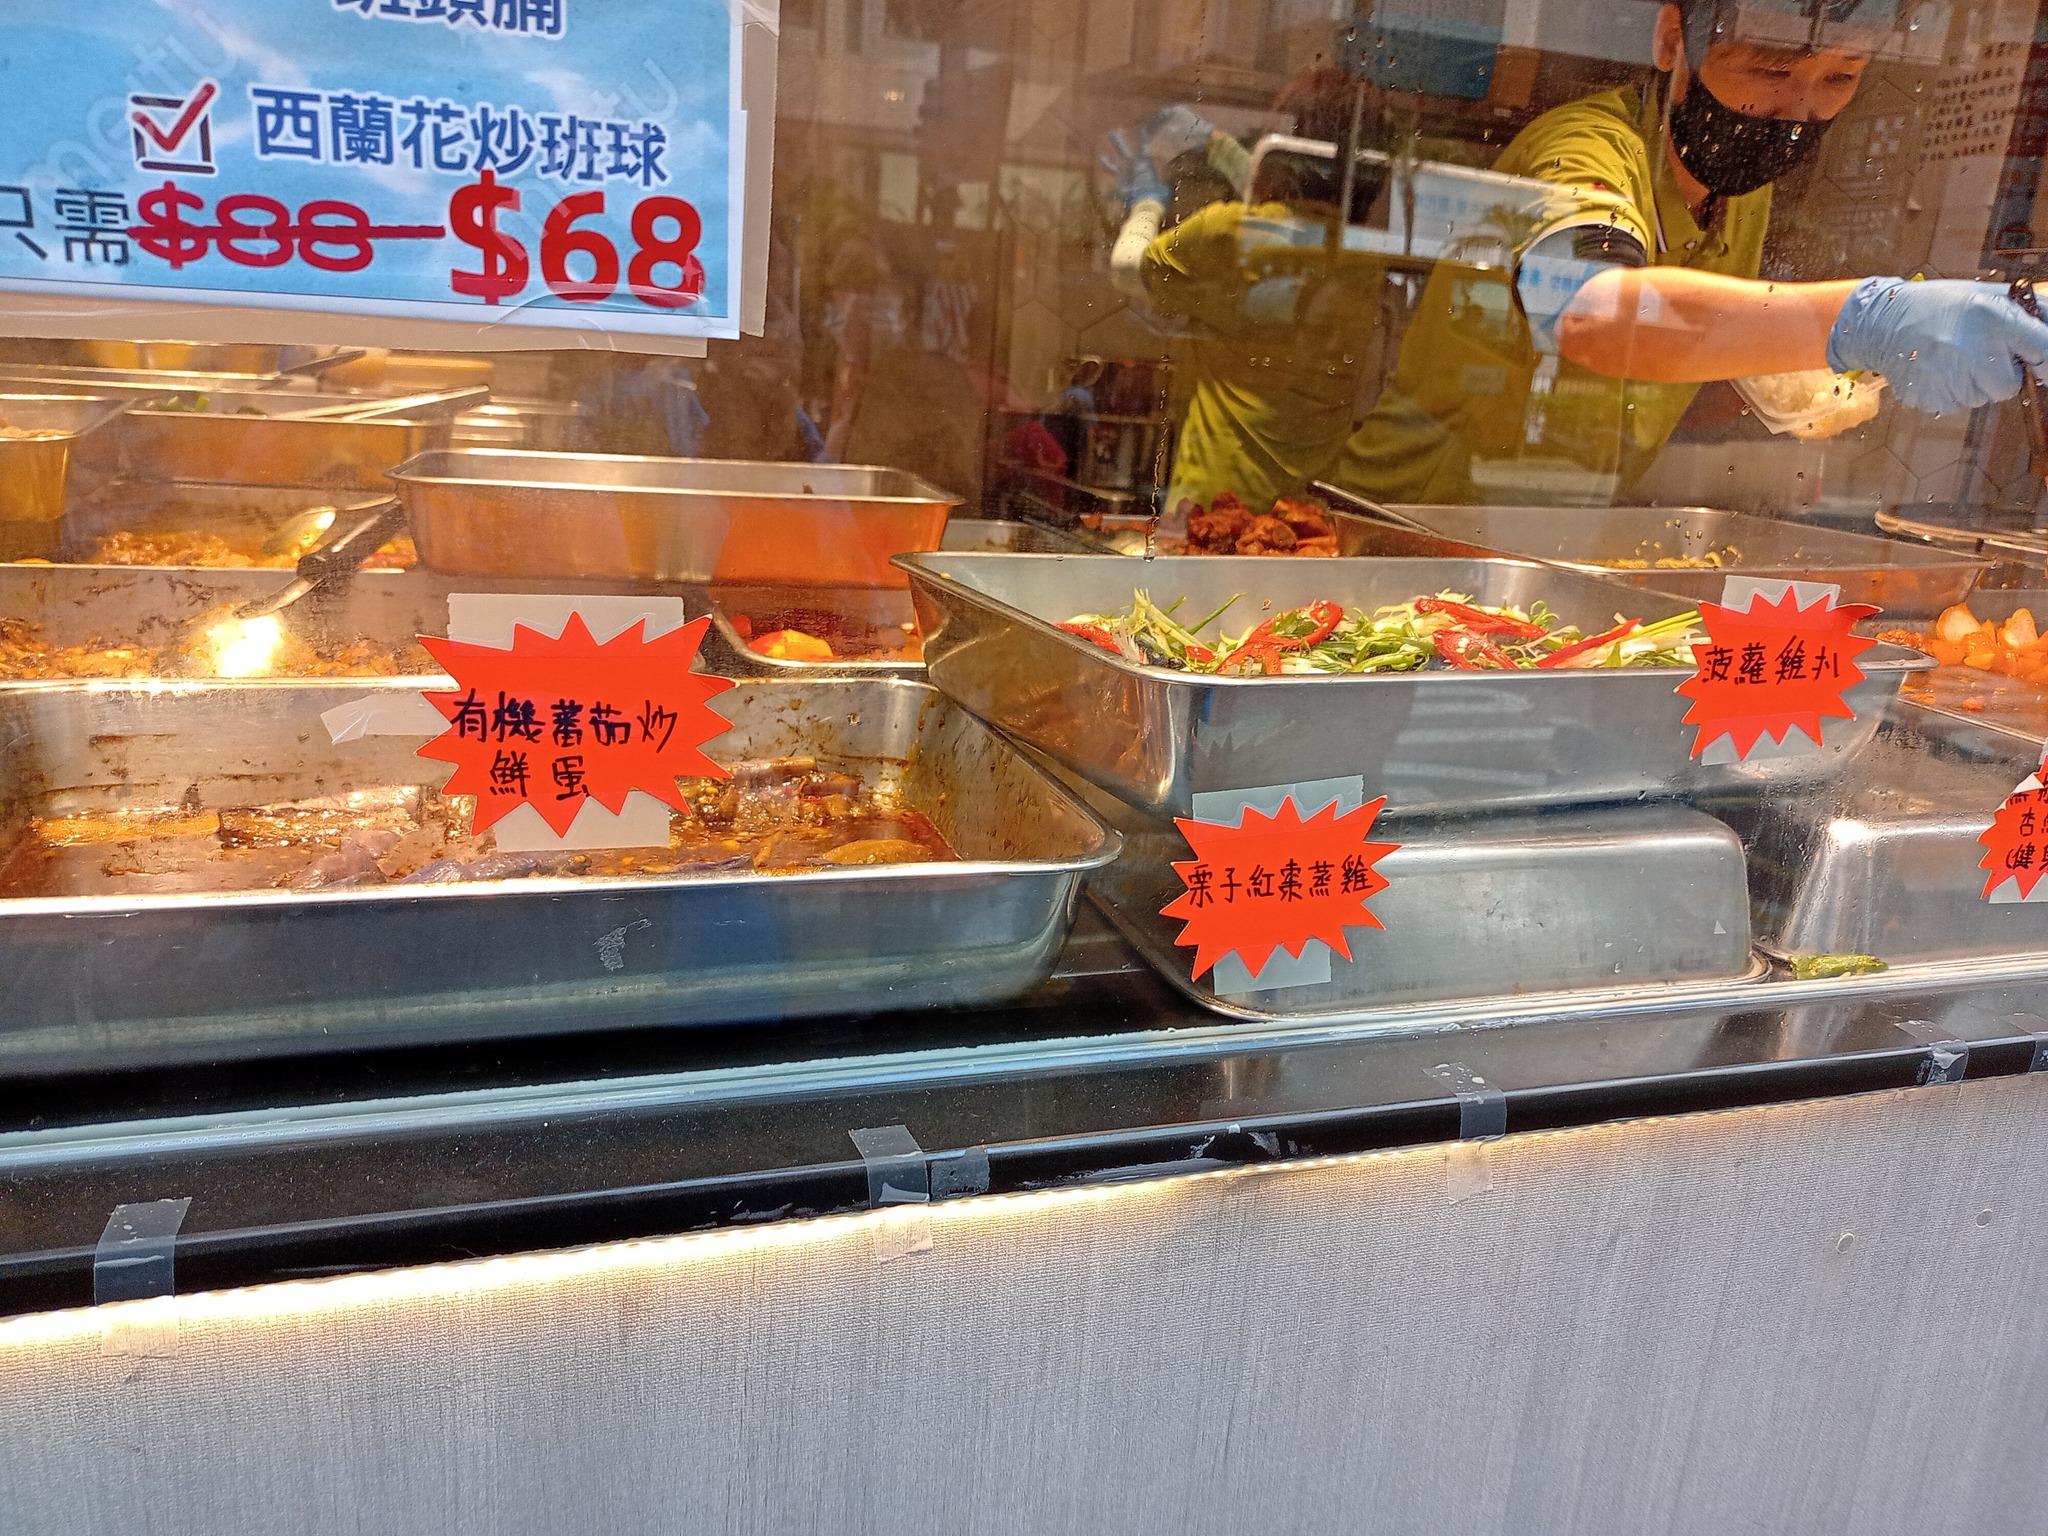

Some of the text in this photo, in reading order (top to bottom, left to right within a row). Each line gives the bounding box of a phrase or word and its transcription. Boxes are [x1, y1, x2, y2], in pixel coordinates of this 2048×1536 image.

[252, 87, 668, 187] 西蘭花炒班球
[449, 169, 706, 309] $68
[451, 688, 678, 753] 有機蕃茄炒
[489, 750, 590, 800] 鮮蛋
[1187, 854, 1374, 908] 栗子紅棗蒸雞
